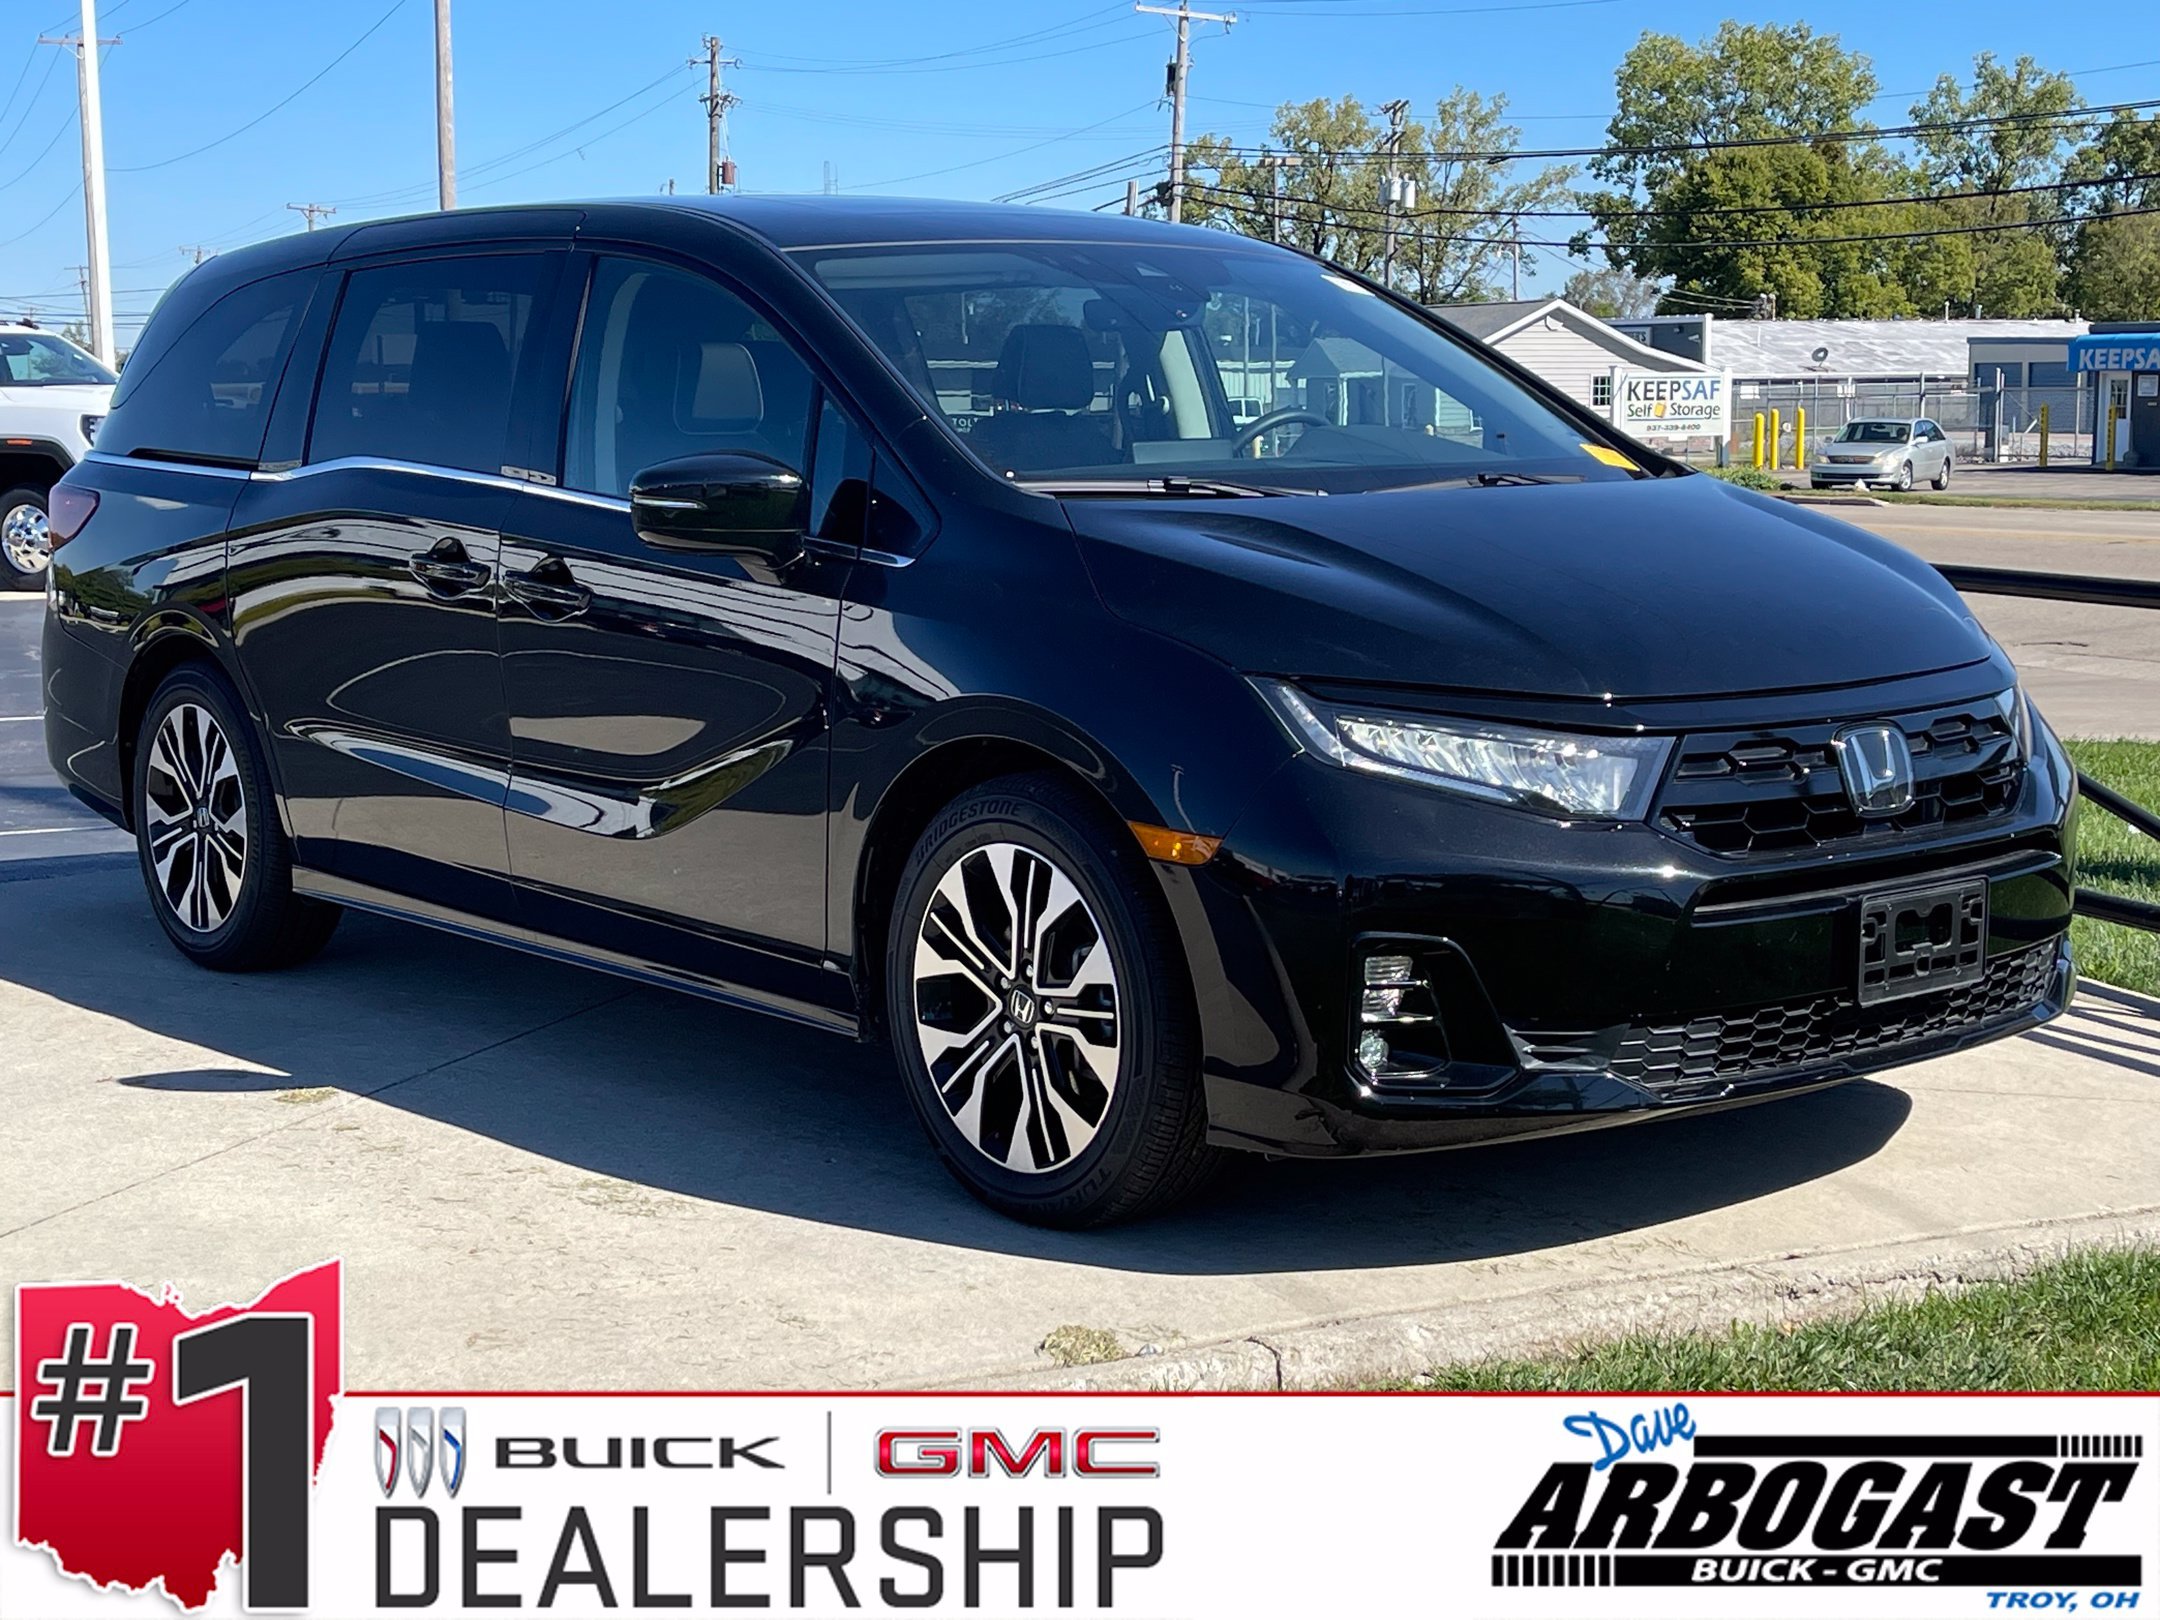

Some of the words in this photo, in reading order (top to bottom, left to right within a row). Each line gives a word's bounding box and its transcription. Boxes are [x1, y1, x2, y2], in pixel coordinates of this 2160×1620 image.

[2079, 348, 2160, 369] KEEPSA
[1626, 380, 1721, 401] KEEPSAF
[1627, 404, 1653, 418] Self
[1669, 403, 1721, 420] Storage
[914, 800, 1025, 868] BRIDGESTONE
